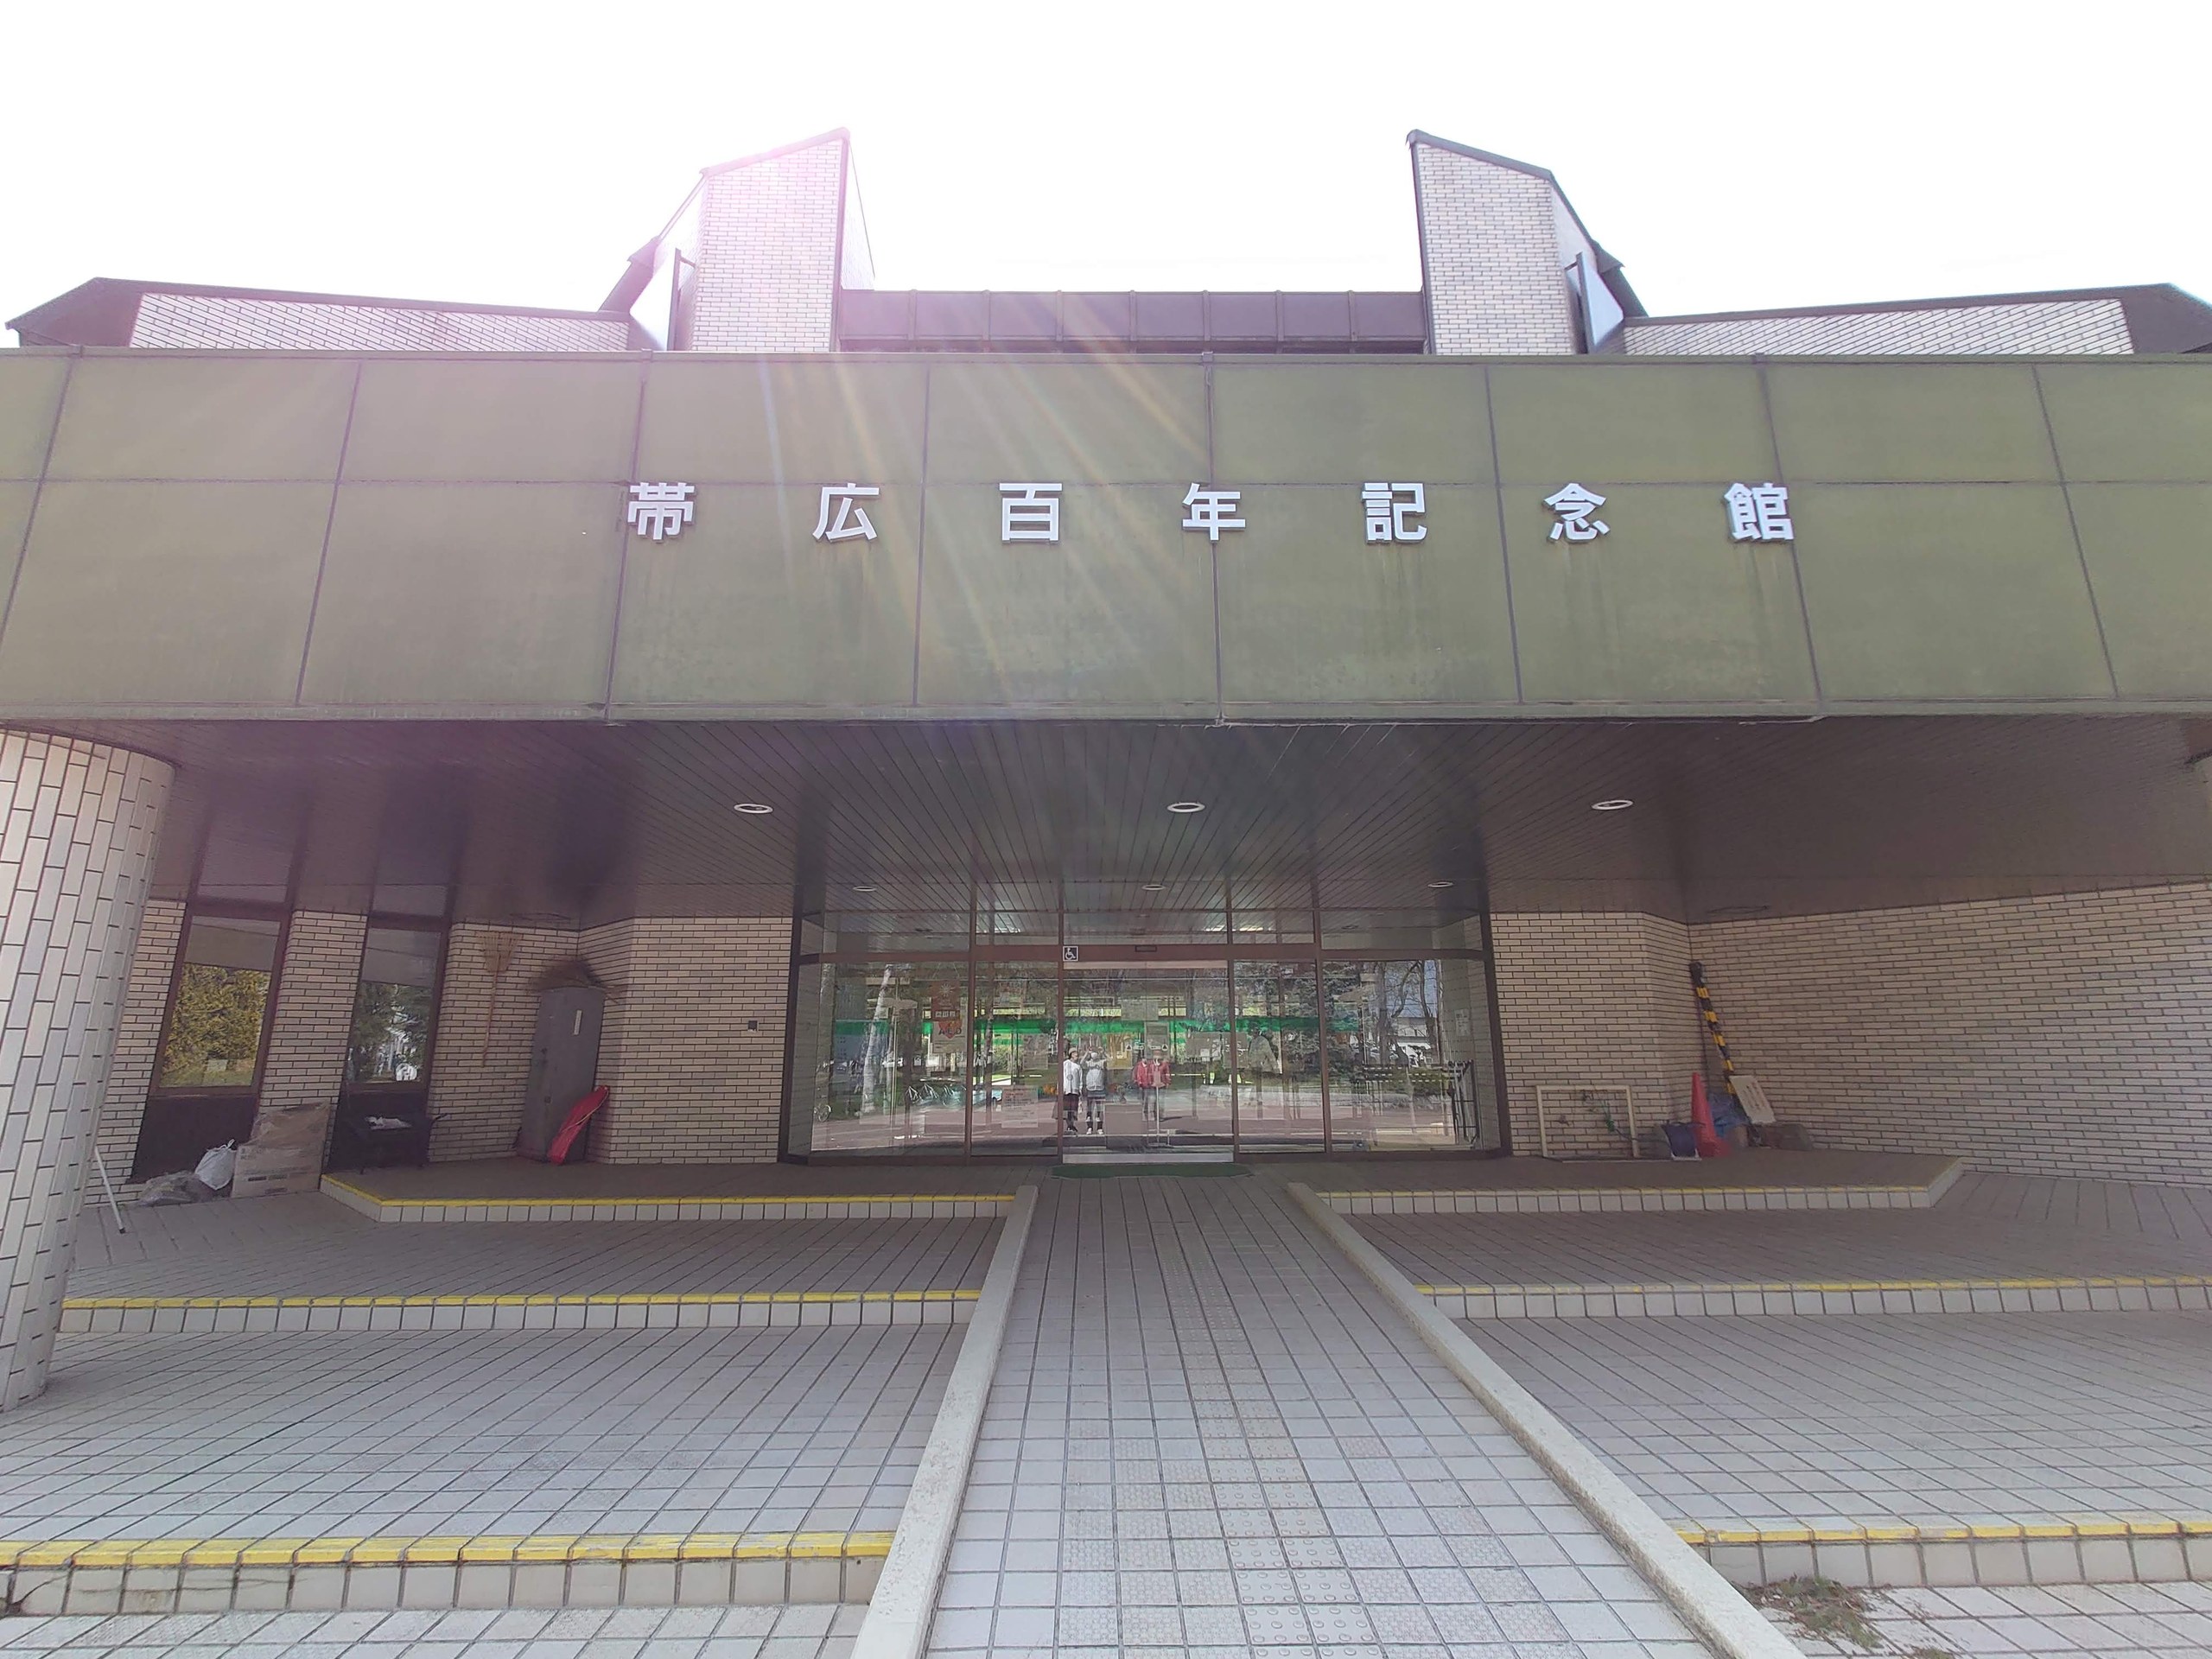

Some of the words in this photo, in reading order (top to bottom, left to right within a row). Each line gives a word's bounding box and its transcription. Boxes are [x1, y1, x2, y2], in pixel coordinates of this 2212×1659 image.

[627, 481, 1795, 543] 帯広百年記念館
